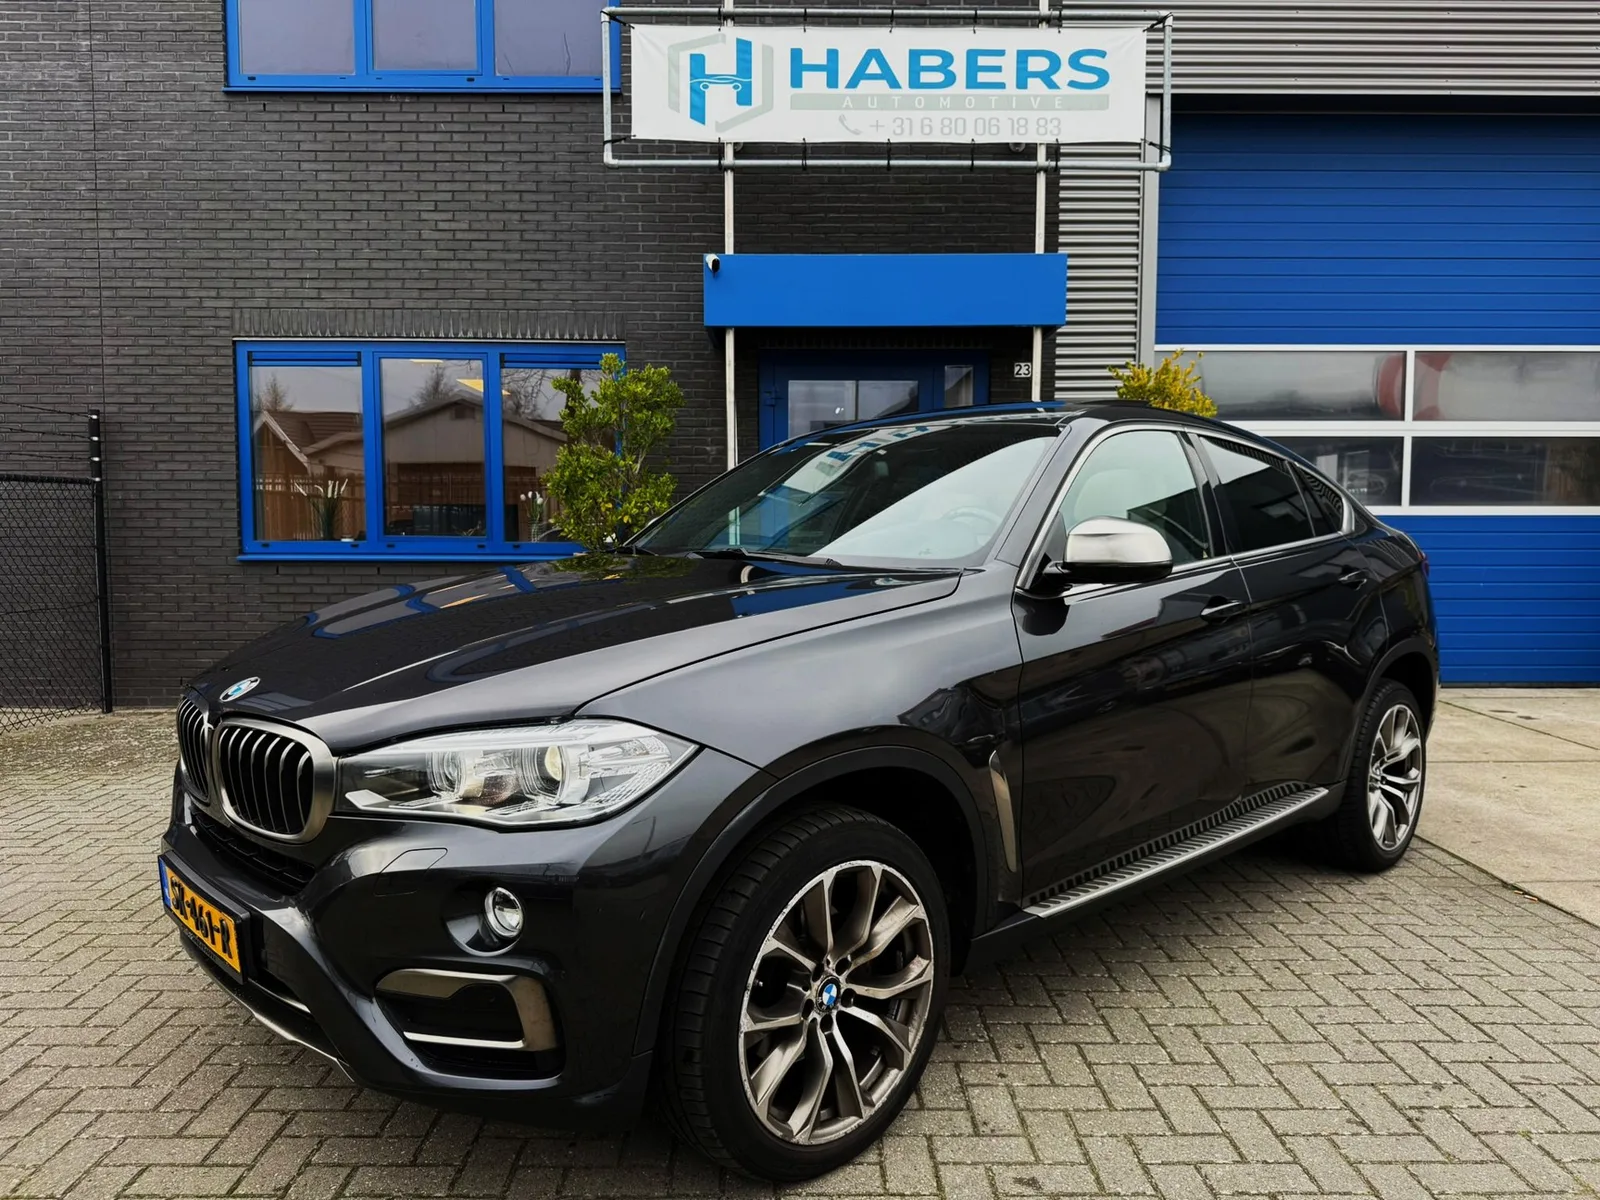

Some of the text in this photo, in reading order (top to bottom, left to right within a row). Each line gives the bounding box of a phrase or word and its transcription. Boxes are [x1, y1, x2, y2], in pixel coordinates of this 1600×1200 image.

[789, 48, 1110, 90] HABERS
[842, 96, 1063, 109] AUTOMOTIVE
[920, 117, 933, 136] 6
[940, 117, 967, 136] 80
[974, 117, 1000, 136] 06
[1007, 117, 1028, 136] 18
[1036, 117, 1061, 136] 83
[1015, 363, 1031, 376] 23
